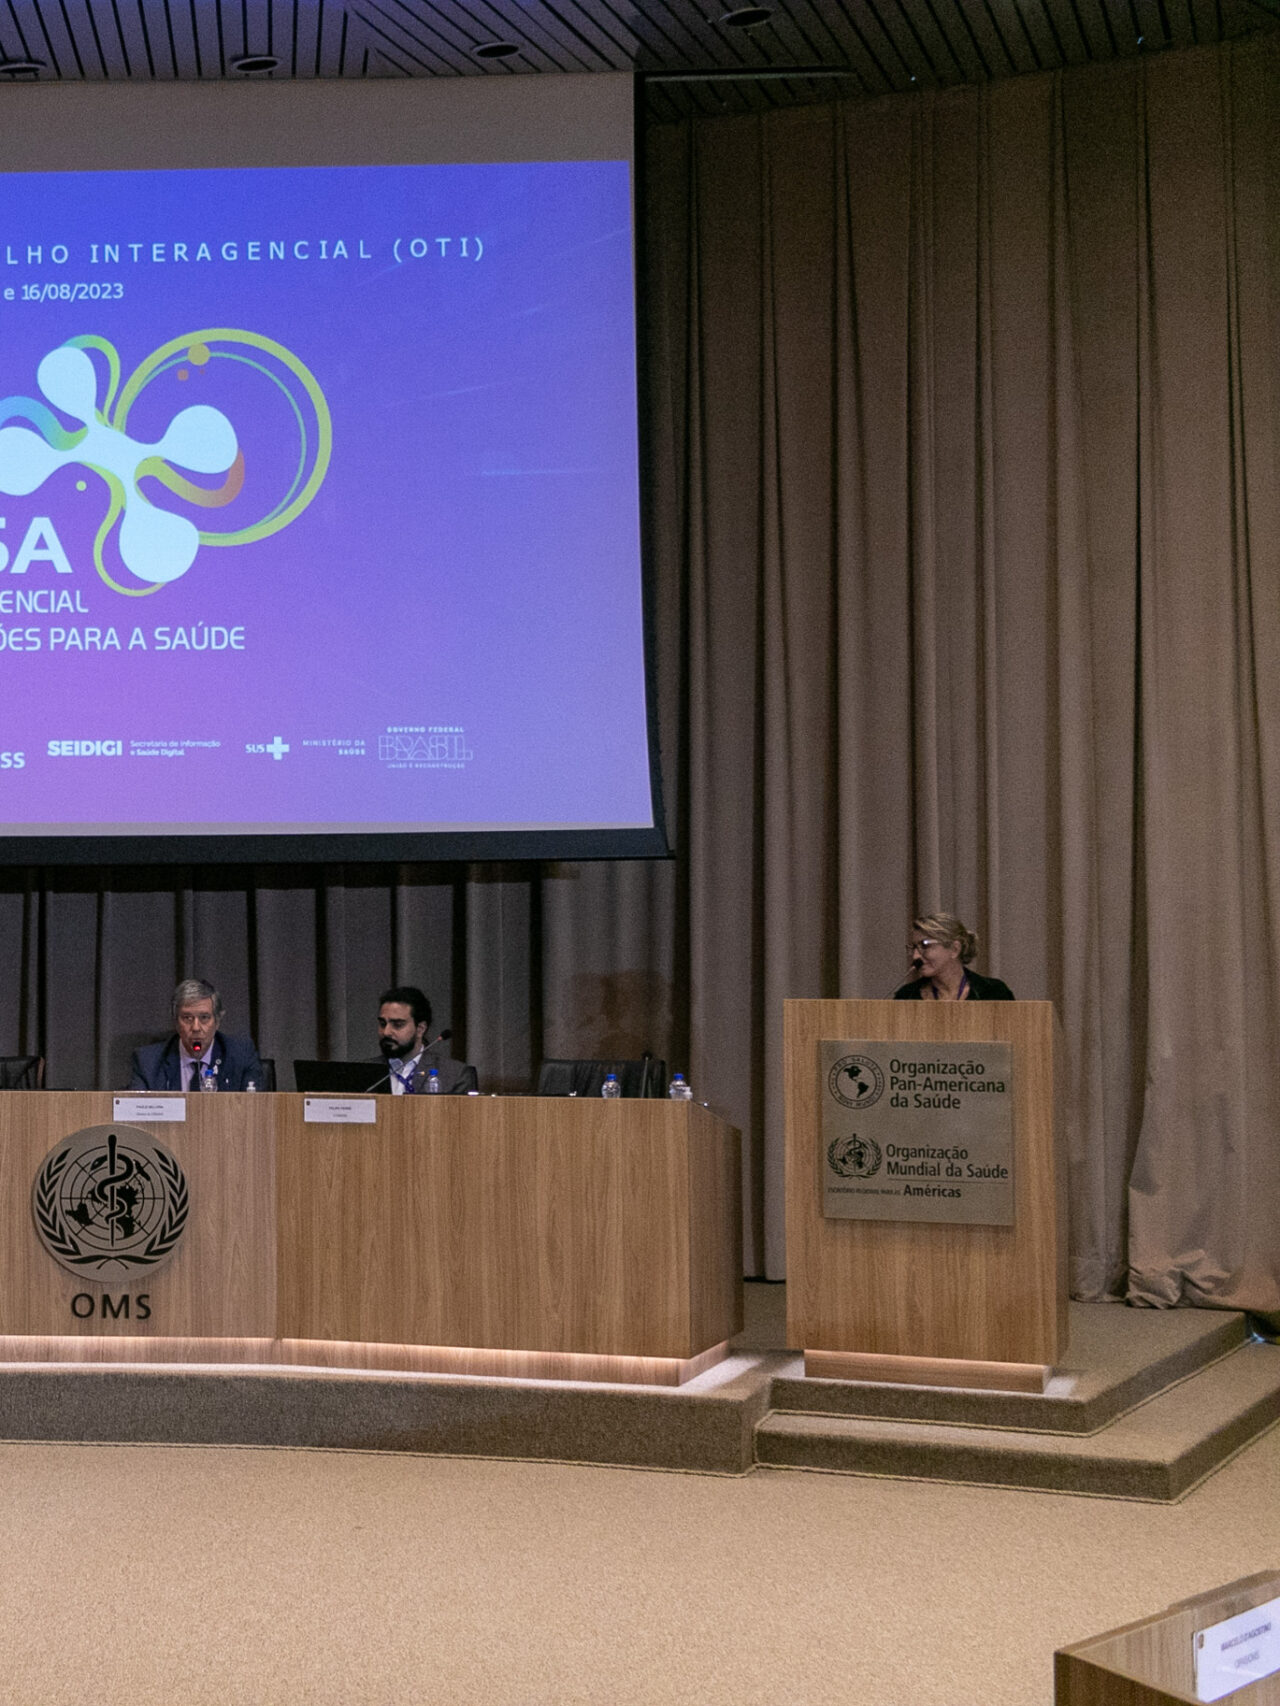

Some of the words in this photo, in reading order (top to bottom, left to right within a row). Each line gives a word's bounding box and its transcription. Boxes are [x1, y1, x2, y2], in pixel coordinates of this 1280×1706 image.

[90, 240, 372, 264] INTERAGENCIAL
[393, 237, 484, 263] (OTI)
[4, 287, 15, 300] e
[21, 283, 124, 303] 16/08/2023
[50, 627, 121, 650] PARA
[128, 627, 147, 650] A
[154, 621, 246, 650] SAÚDE
[47, 740, 122, 756] SEIDIGI
[245, 743, 265, 753] SUS
[302, 738, 355, 746] MINISTÉRIO
[889, 1059, 985, 1078] Organização
[890, 1076, 1005, 1093] Pan-Americana
[890, 1093, 908, 1108] da
[914, 1093, 961, 1109] Saúde
[886, 1143, 968, 1162] Organização
[887, 1162, 940, 1176] Mundial
[946, 1163, 962, 1177] da
[967, 1163, 1008, 1179] Saúde
[903, 1184, 961, 1198] Américas
[71, 1293, 152, 1320] OMS
